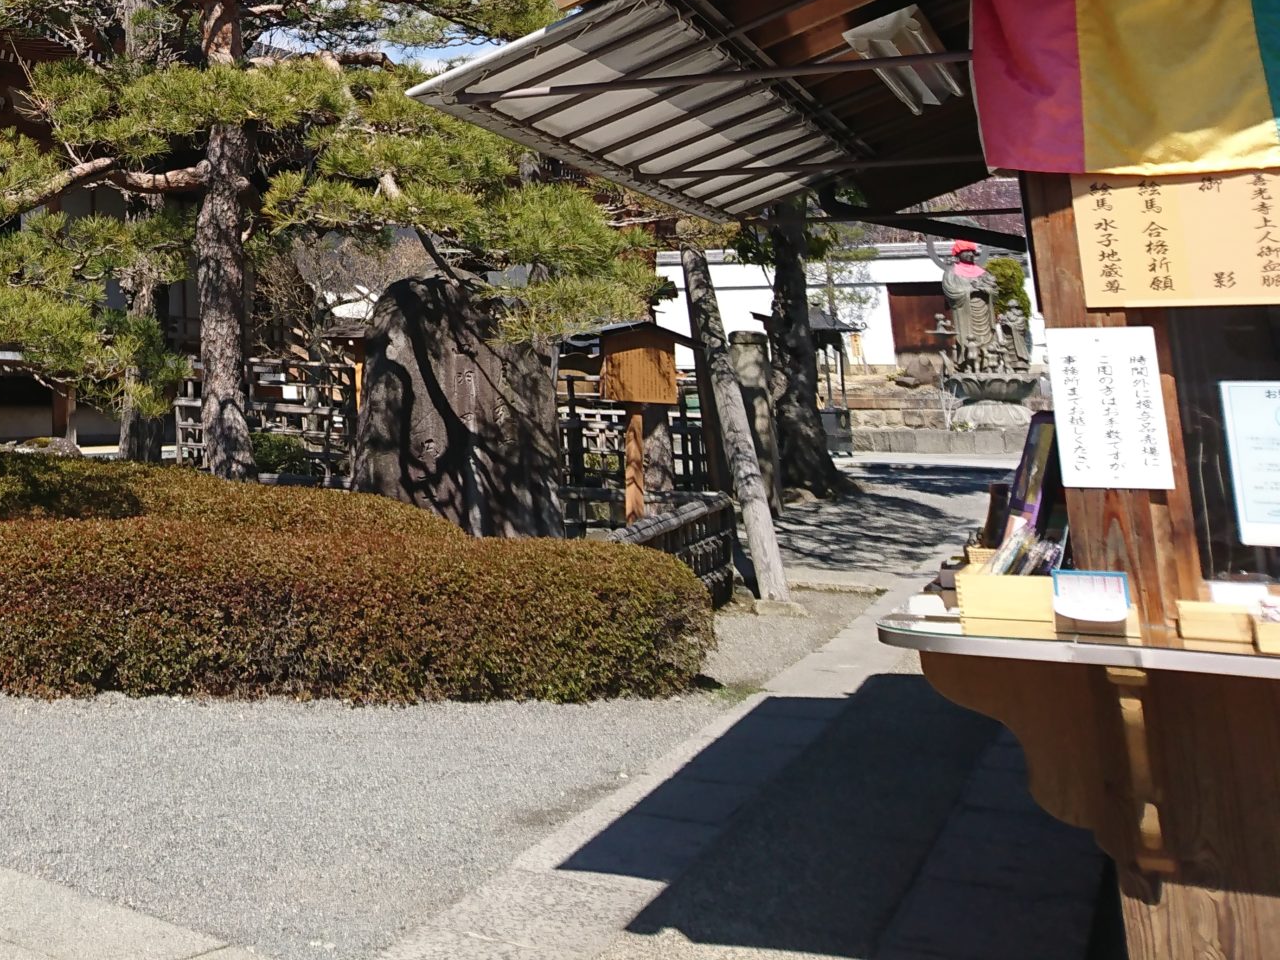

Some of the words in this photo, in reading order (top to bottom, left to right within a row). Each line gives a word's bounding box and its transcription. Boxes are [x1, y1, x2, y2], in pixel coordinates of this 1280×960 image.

[1089, 182, 1114, 212] 絵馬
[1137, 179, 1163, 214] 絵馬
[1094, 218, 1126, 294] 水子地蔵尊
[1142, 221, 1176, 291] 合格祈願
